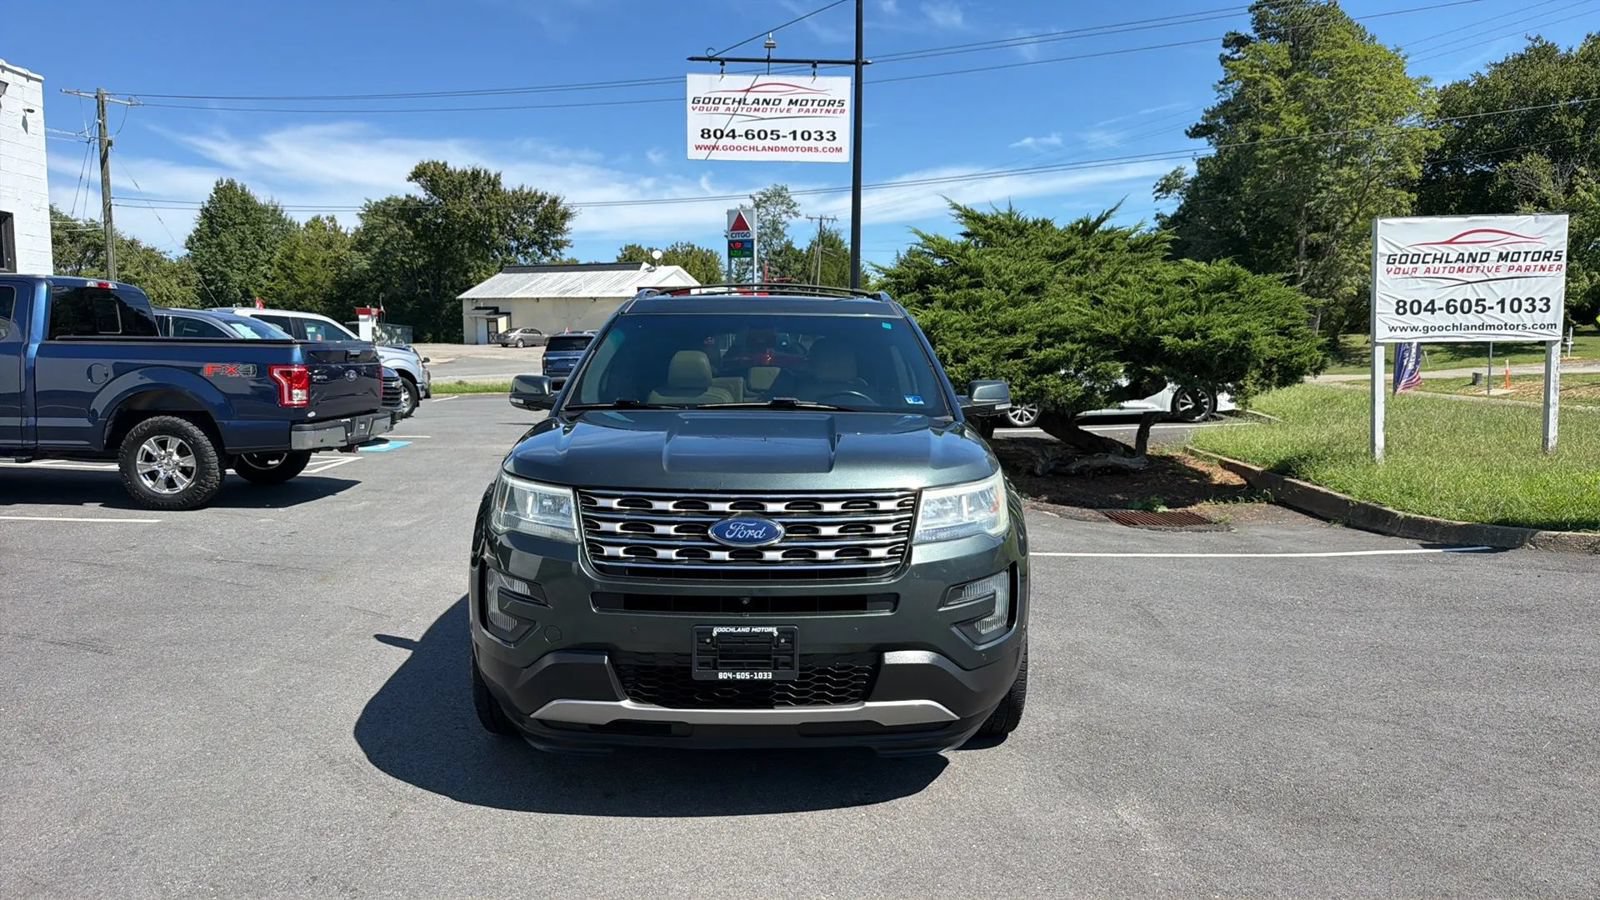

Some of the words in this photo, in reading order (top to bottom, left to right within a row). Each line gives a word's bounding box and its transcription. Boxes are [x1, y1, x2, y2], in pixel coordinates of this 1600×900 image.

[691, 96, 782, 107] GOOCHLAND
[787, 98, 845, 107] MOTORS
[724, 106, 793, 114] AUTOMOTIVE
[700, 128, 837, 142] 804-605-1033
[694, 143, 843, 153] WWW.GOOCHLANDMOTORS.COM
[1386, 251, 1491, 265] GOOCHLAND
[1496, 250, 1563, 262] MOTORS
[1385, 267, 1418, 275] YOUR
[1424, 265, 1502, 275] AUTOMOTIVE
[1507, 263, 1563, 273] PARTNER
[1395, 297, 1551, 315] 804-605-1033
[1388, 321, 1558, 334] www.goochlandmotors.com
[725, 521, 766, 539] Ford
[718, 672, 772, 680] 804-605-1033
